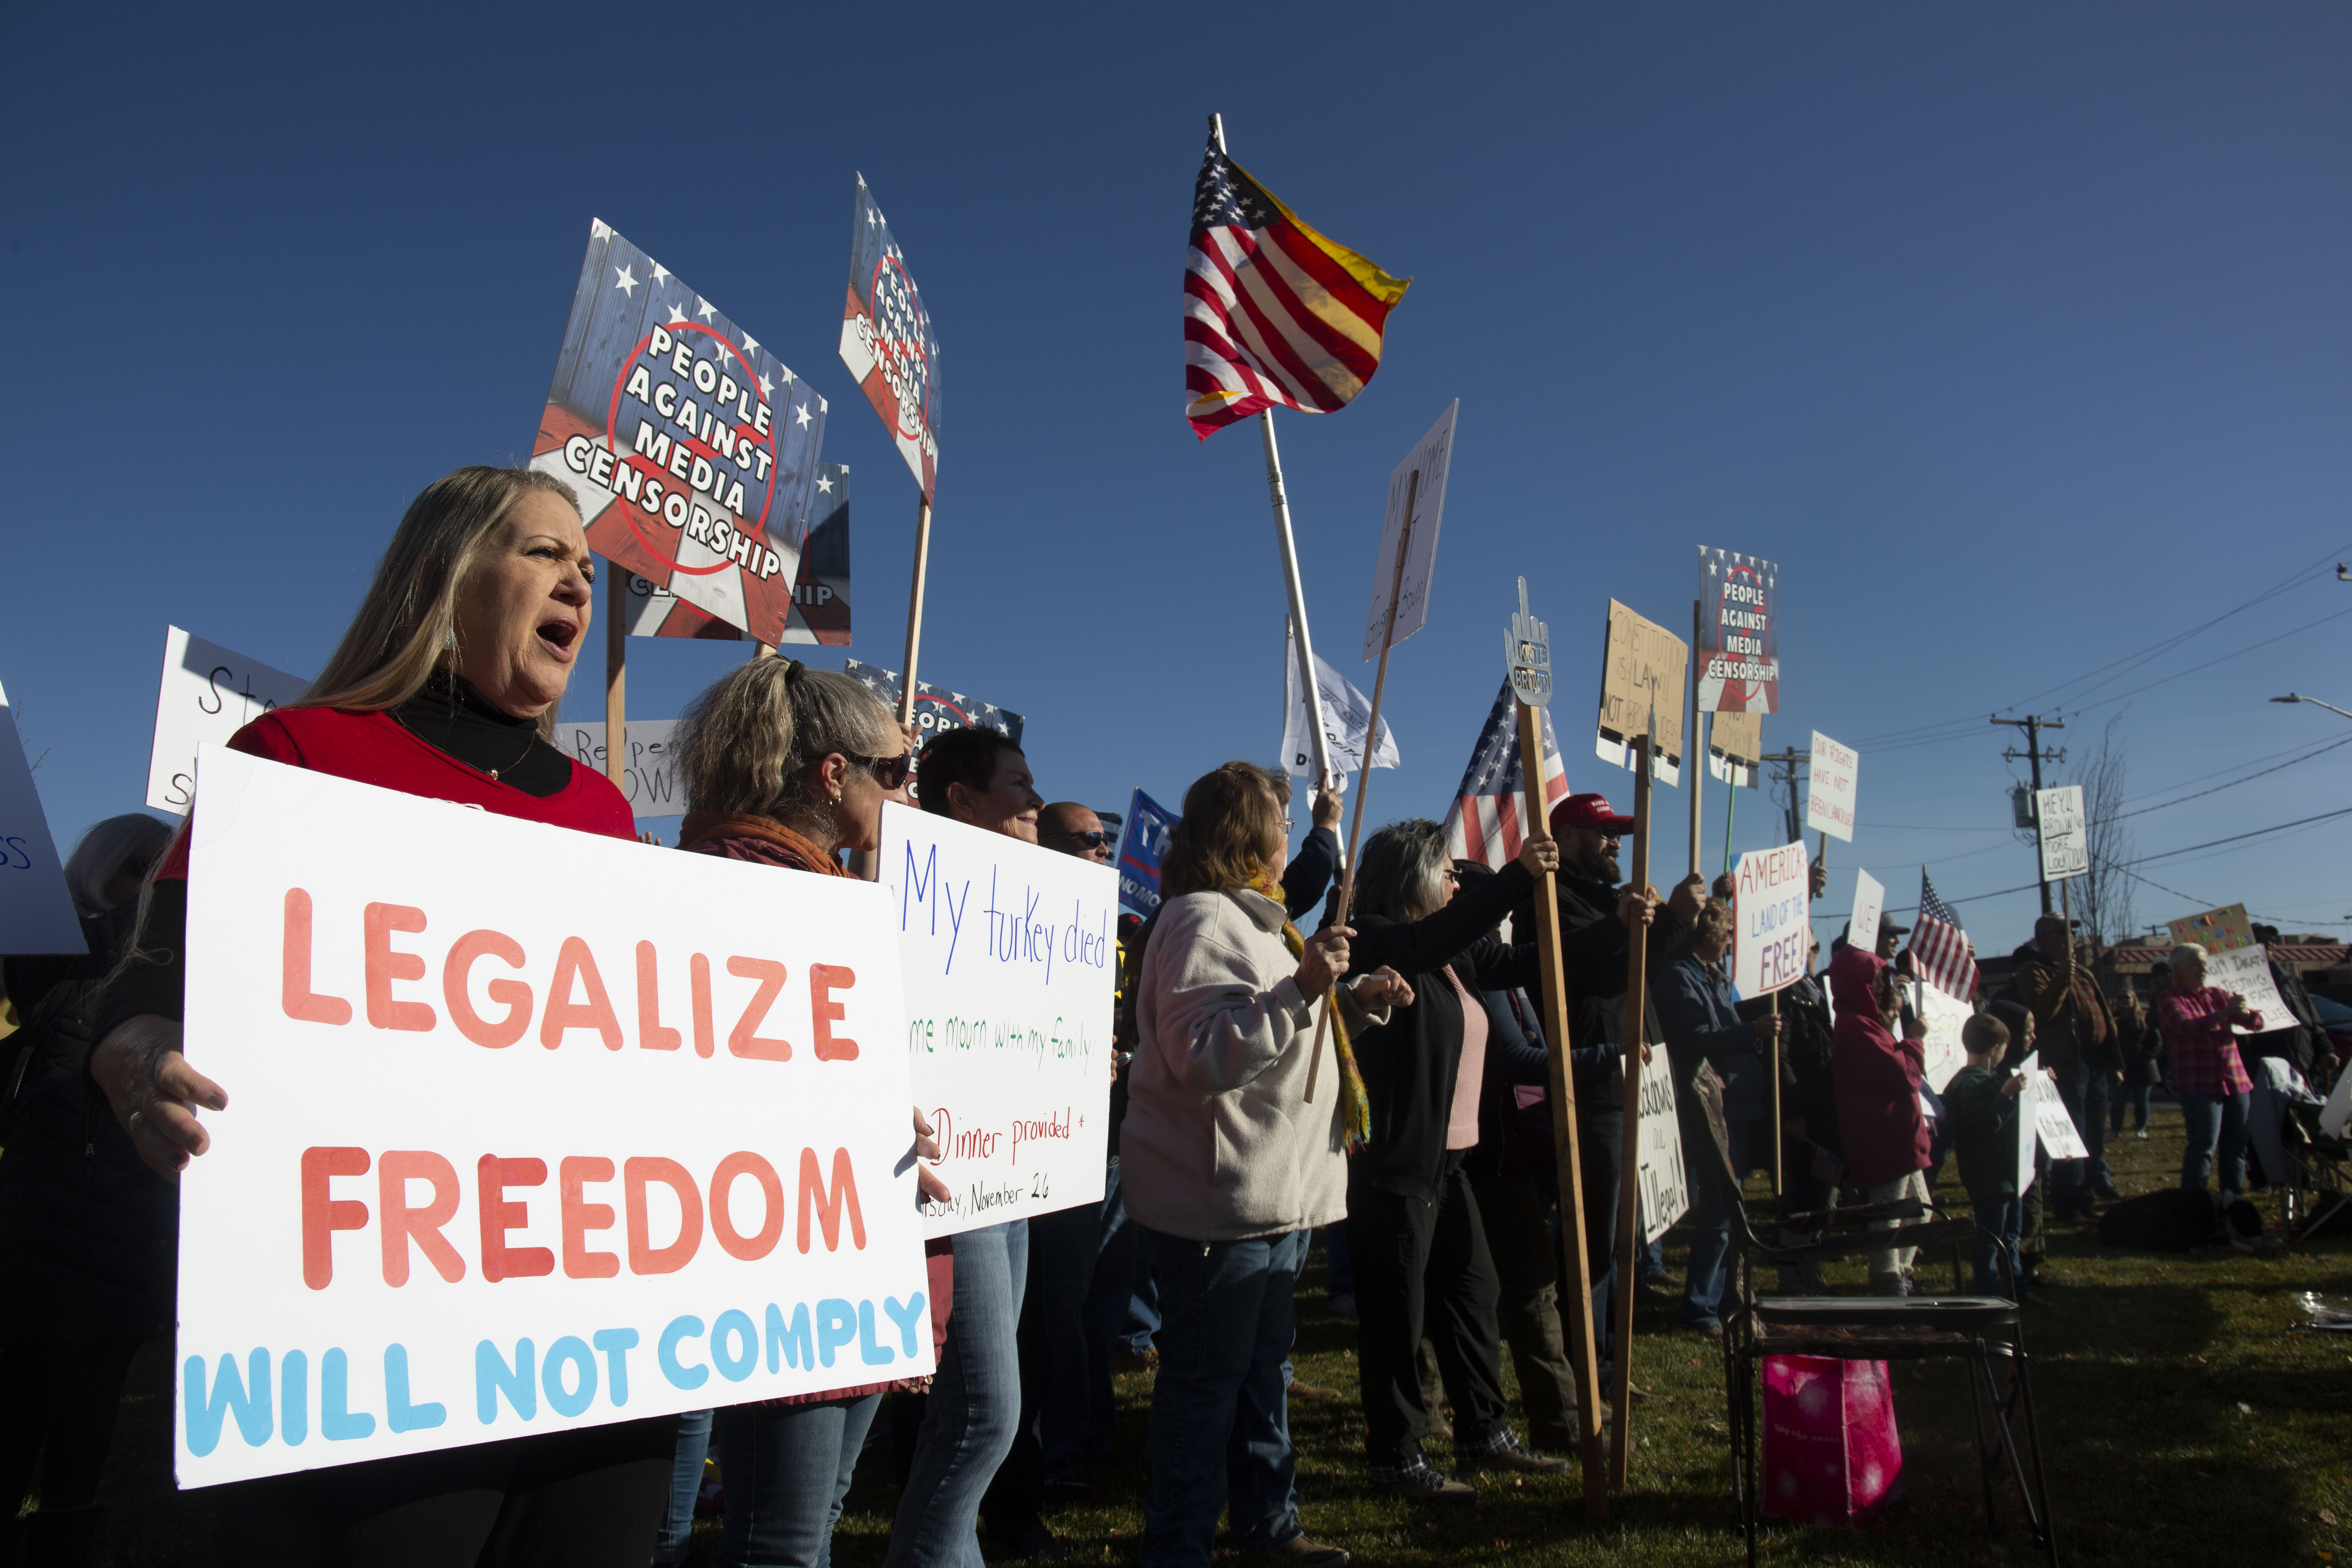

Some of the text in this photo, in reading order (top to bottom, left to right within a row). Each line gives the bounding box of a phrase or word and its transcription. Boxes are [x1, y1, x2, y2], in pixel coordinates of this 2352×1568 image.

[882, 254, 925, 356] PEOPLE
[876, 278, 927, 385] AGAINST
[648, 325, 773, 438] PEOPLE
[856, 313, 933, 458] CENSORSHIP
[881, 317, 920, 406] MEDIA
[627, 365, 773, 482] AGAINST
[633, 420, 744, 518] MEDIA
[564, 433, 781, 582] CENSORSHIP
[1724, 582, 1764, 606] PEOPLE
[1611, 612, 1684, 676] CONSTITUTION
[1720, 608, 1766, 631] AGAINST
[1518, 643, 1547, 665] KATE
[1617, 657, 1626, 680] IS
[1708, 659, 1774, 682] CENSORSHIP
[1727, 635, 1762, 656] MEDIA
[1515, 670, 1549, 693] BROWN
[1342, 711, 1367, 729] MINUTE
[1604, 691, 1623, 723] NOT
[1814, 737, 1853, 769] OUR RIGHTS
[1813, 766, 1849, 792] HAVE NOT
[2042, 789, 2073, 815] HEY!!
[1810, 794, 1826, 818] BEEN
[903, 840, 969, 975] My
[1119, 876, 1138, 894] NO
[1752, 893, 1803, 938] LAND OF THE
[1858, 901, 1875, 933] WE
[282, 887, 859, 1062] LEGALIZE
[1761, 925, 1804, 988] FREE!
[909, 1018, 933, 1054] me
[946, 1016, 987, 1049] mourn
[995, 1020, 1022, 1049] with
[1028, 1025, 1046, 1071] my
[1639, 1062, 1673, 1119] ockdowns
[930, 1107, 1070, 1166] Dinner provided
[1653, 1128, 1666, 1150] are
[971, 1180, 1023, 1215] November
[1031, 1173, 1049, 1198] 26
[1641, 1137, 1686, 1233] Illegal!
[301, 1146, 867, 1291] FREEDOM
[183, 1292, 926, 1457] WILL NOT COMPLY
